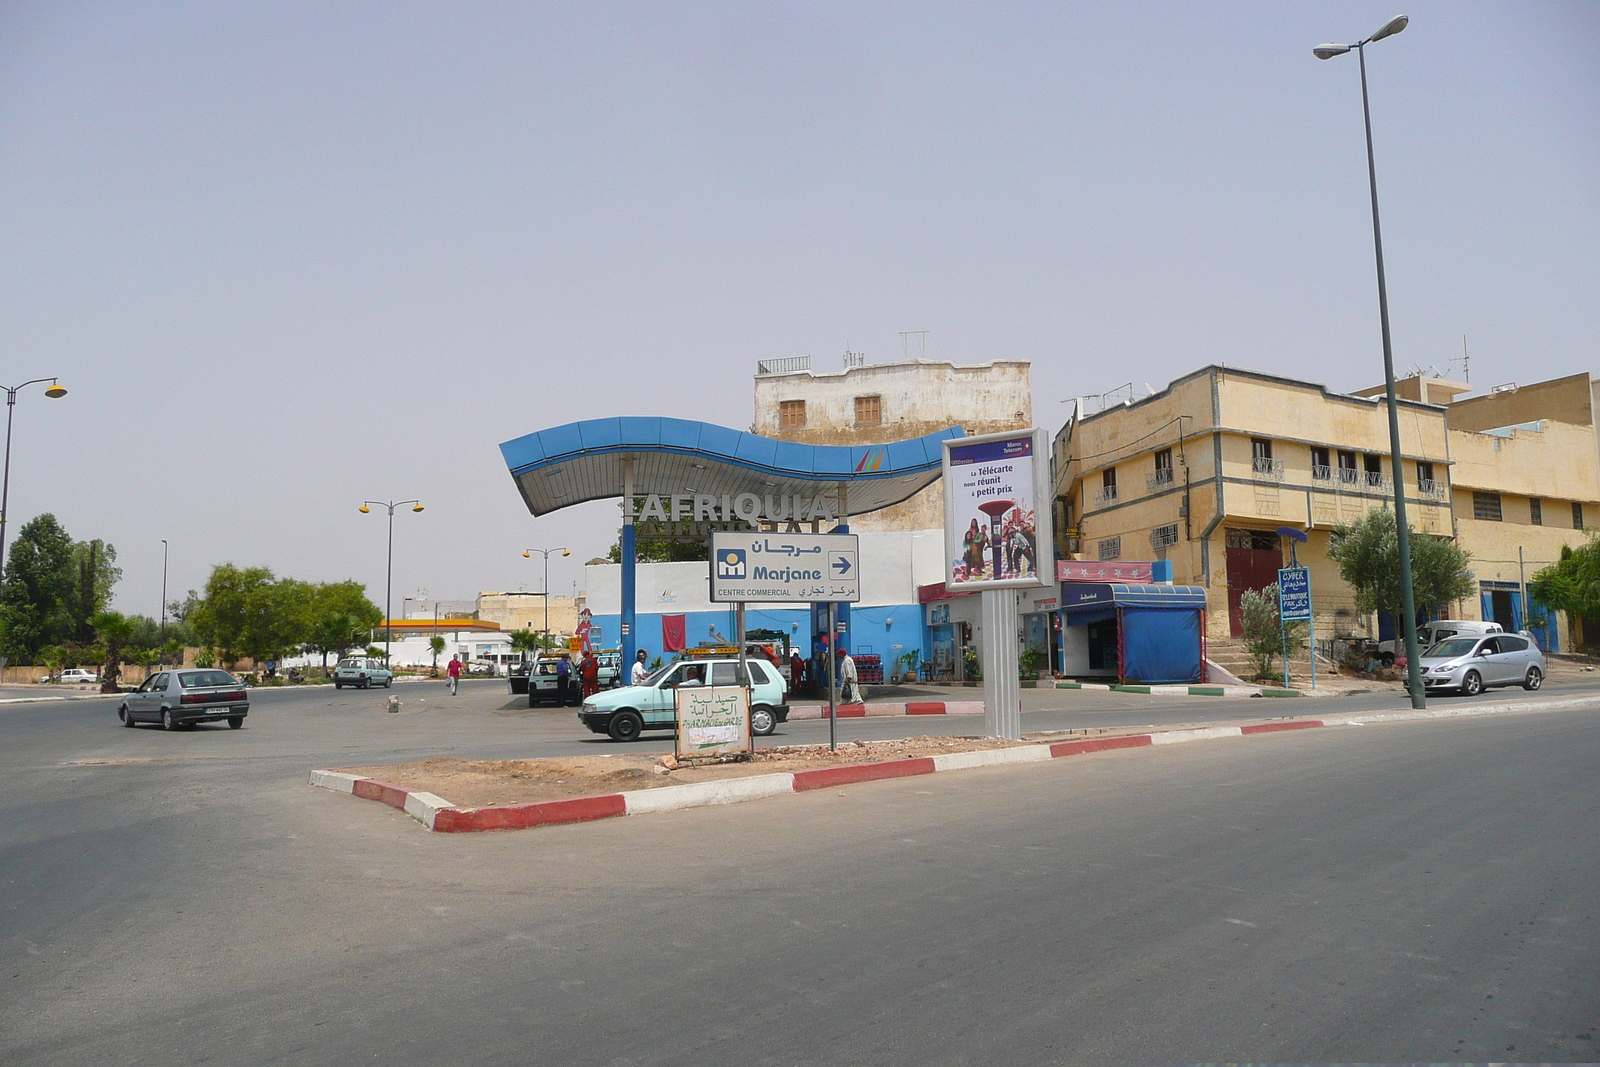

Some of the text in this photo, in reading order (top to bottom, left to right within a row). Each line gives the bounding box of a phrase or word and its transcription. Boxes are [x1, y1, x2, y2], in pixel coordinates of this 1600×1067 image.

[978, 464, 1014, 476] Télécarte
[977, 476, 1001, 486] réunit
[976, 486, 995, 498] petit
[997, 484, 1013, 496] prix
[639, 492, 834, 527] AFRIQUIA
[751, 539, 822, 557] مرجان
[753, 566, 822, 583] Marjane
[1283, 572, 1304, 581] CYBER
[718, 588, 791, 597] CENTRE COMMERCIAL
[799, 585, 856, 598] مركز تجاري
